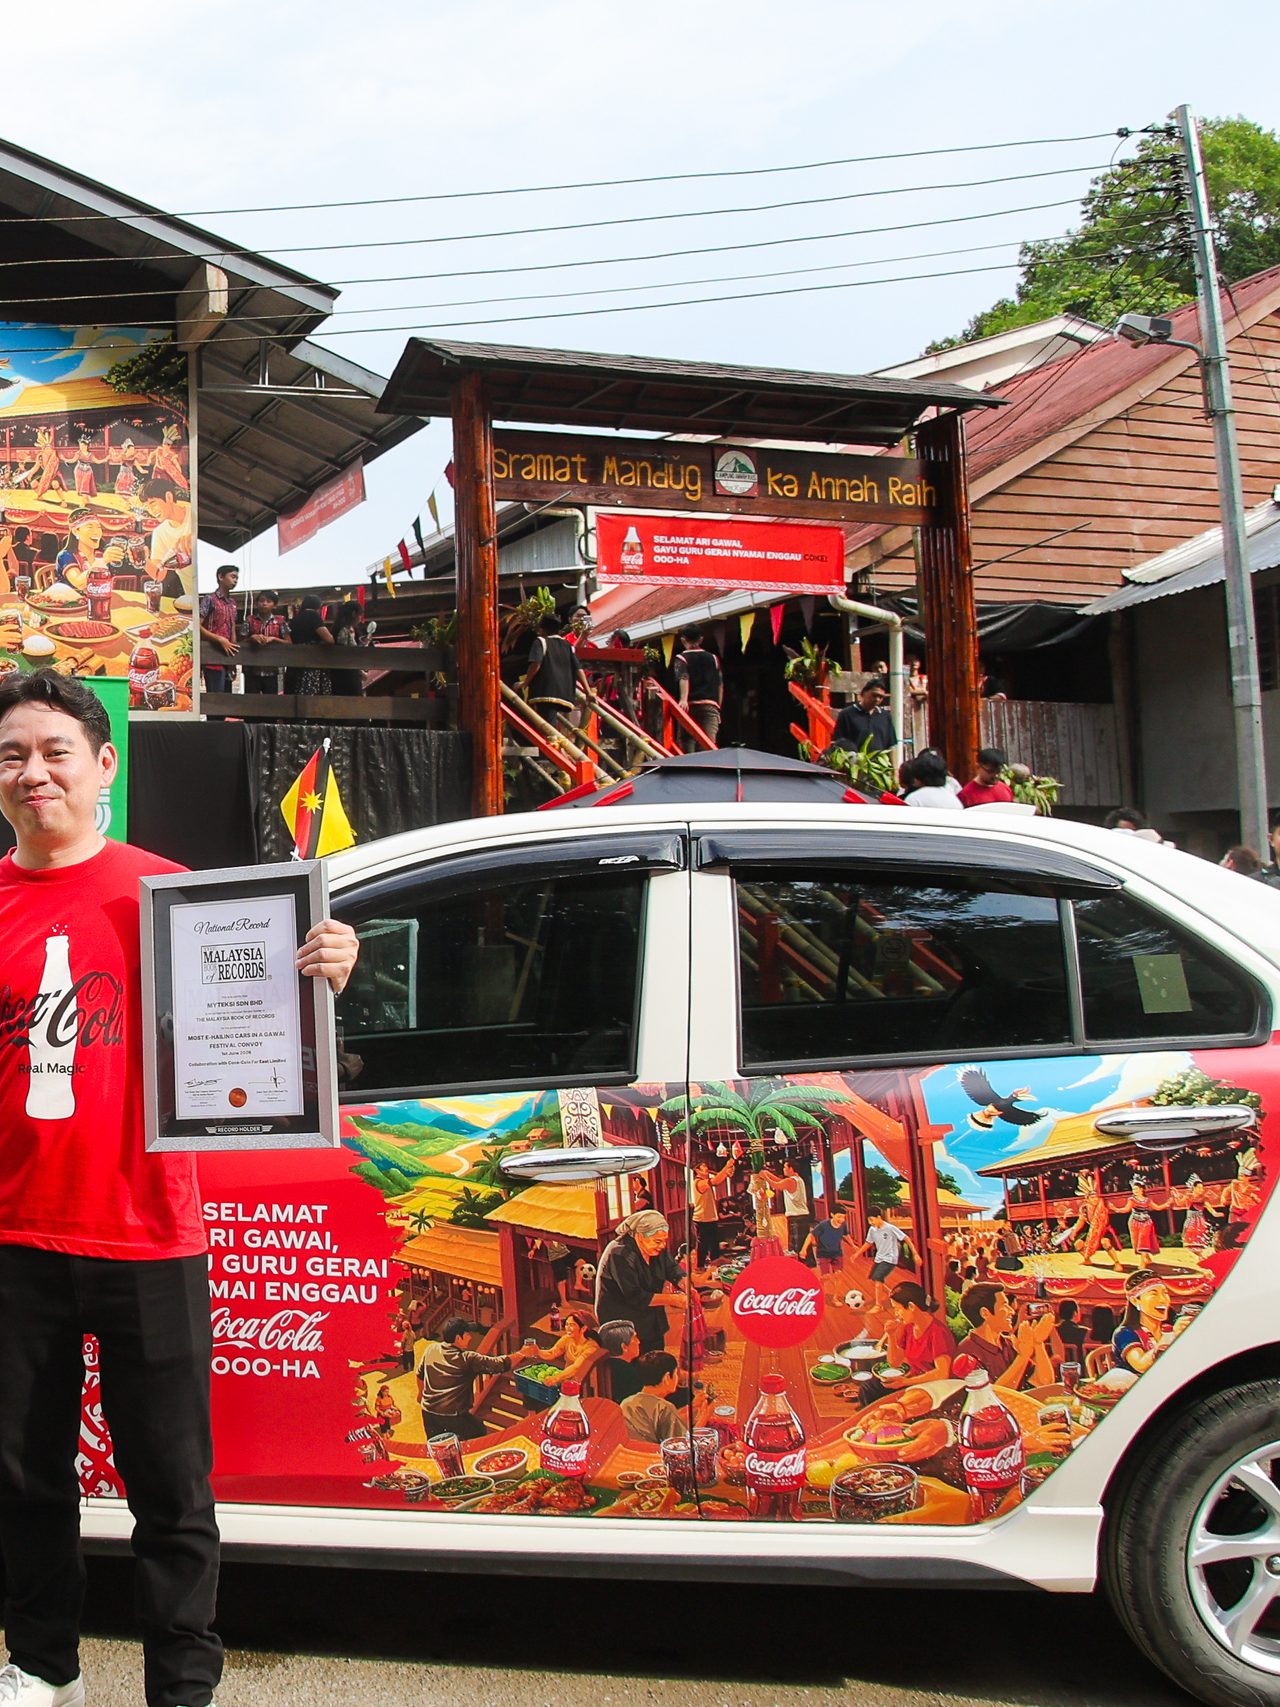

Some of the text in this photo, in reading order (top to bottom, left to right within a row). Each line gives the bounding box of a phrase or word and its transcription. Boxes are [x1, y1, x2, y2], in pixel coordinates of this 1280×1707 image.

[493, 448, 588, 484] Sramat
[807, 471, 879, 504] Annah
[653, 535, 695, 545] SELAMAT
[695, 538, 710, 546] ARI
[653, 545, 677, 554] GAYU
[679, 547, 703, 555] GURU
[704, 548, 731, 557] GERAI
[732, 550, 765, 559] NYAMAI
[766, 551, 801, 561] ENGGAU
[194, 918, 271, 934] National Record
[203, 947, 264, 963] MALAYSIA
[218, 961, 265, 980] RECORDS
[18, 1062, 85, 1075] Real Magic
[202, 1202, 328, 1223] SELAMAT
[243, 1229, 339, 1254] GAWAI,
[222, 1254, 297, 1275] GURU
[305, 1257, 388, 1278] GERAI
[265, 1281, 378, 1304] ENGGAU
[734, 1287, 821, 1316] Coca-Cola
[211, 1356, 321, 1379] OOO-HA
[541, 1438, 590, 1461] Coca-Cola
[962, 1436, 1022, 1473] Coca-Cola
[745, 1447, 807, 1478] Coca-Cola
